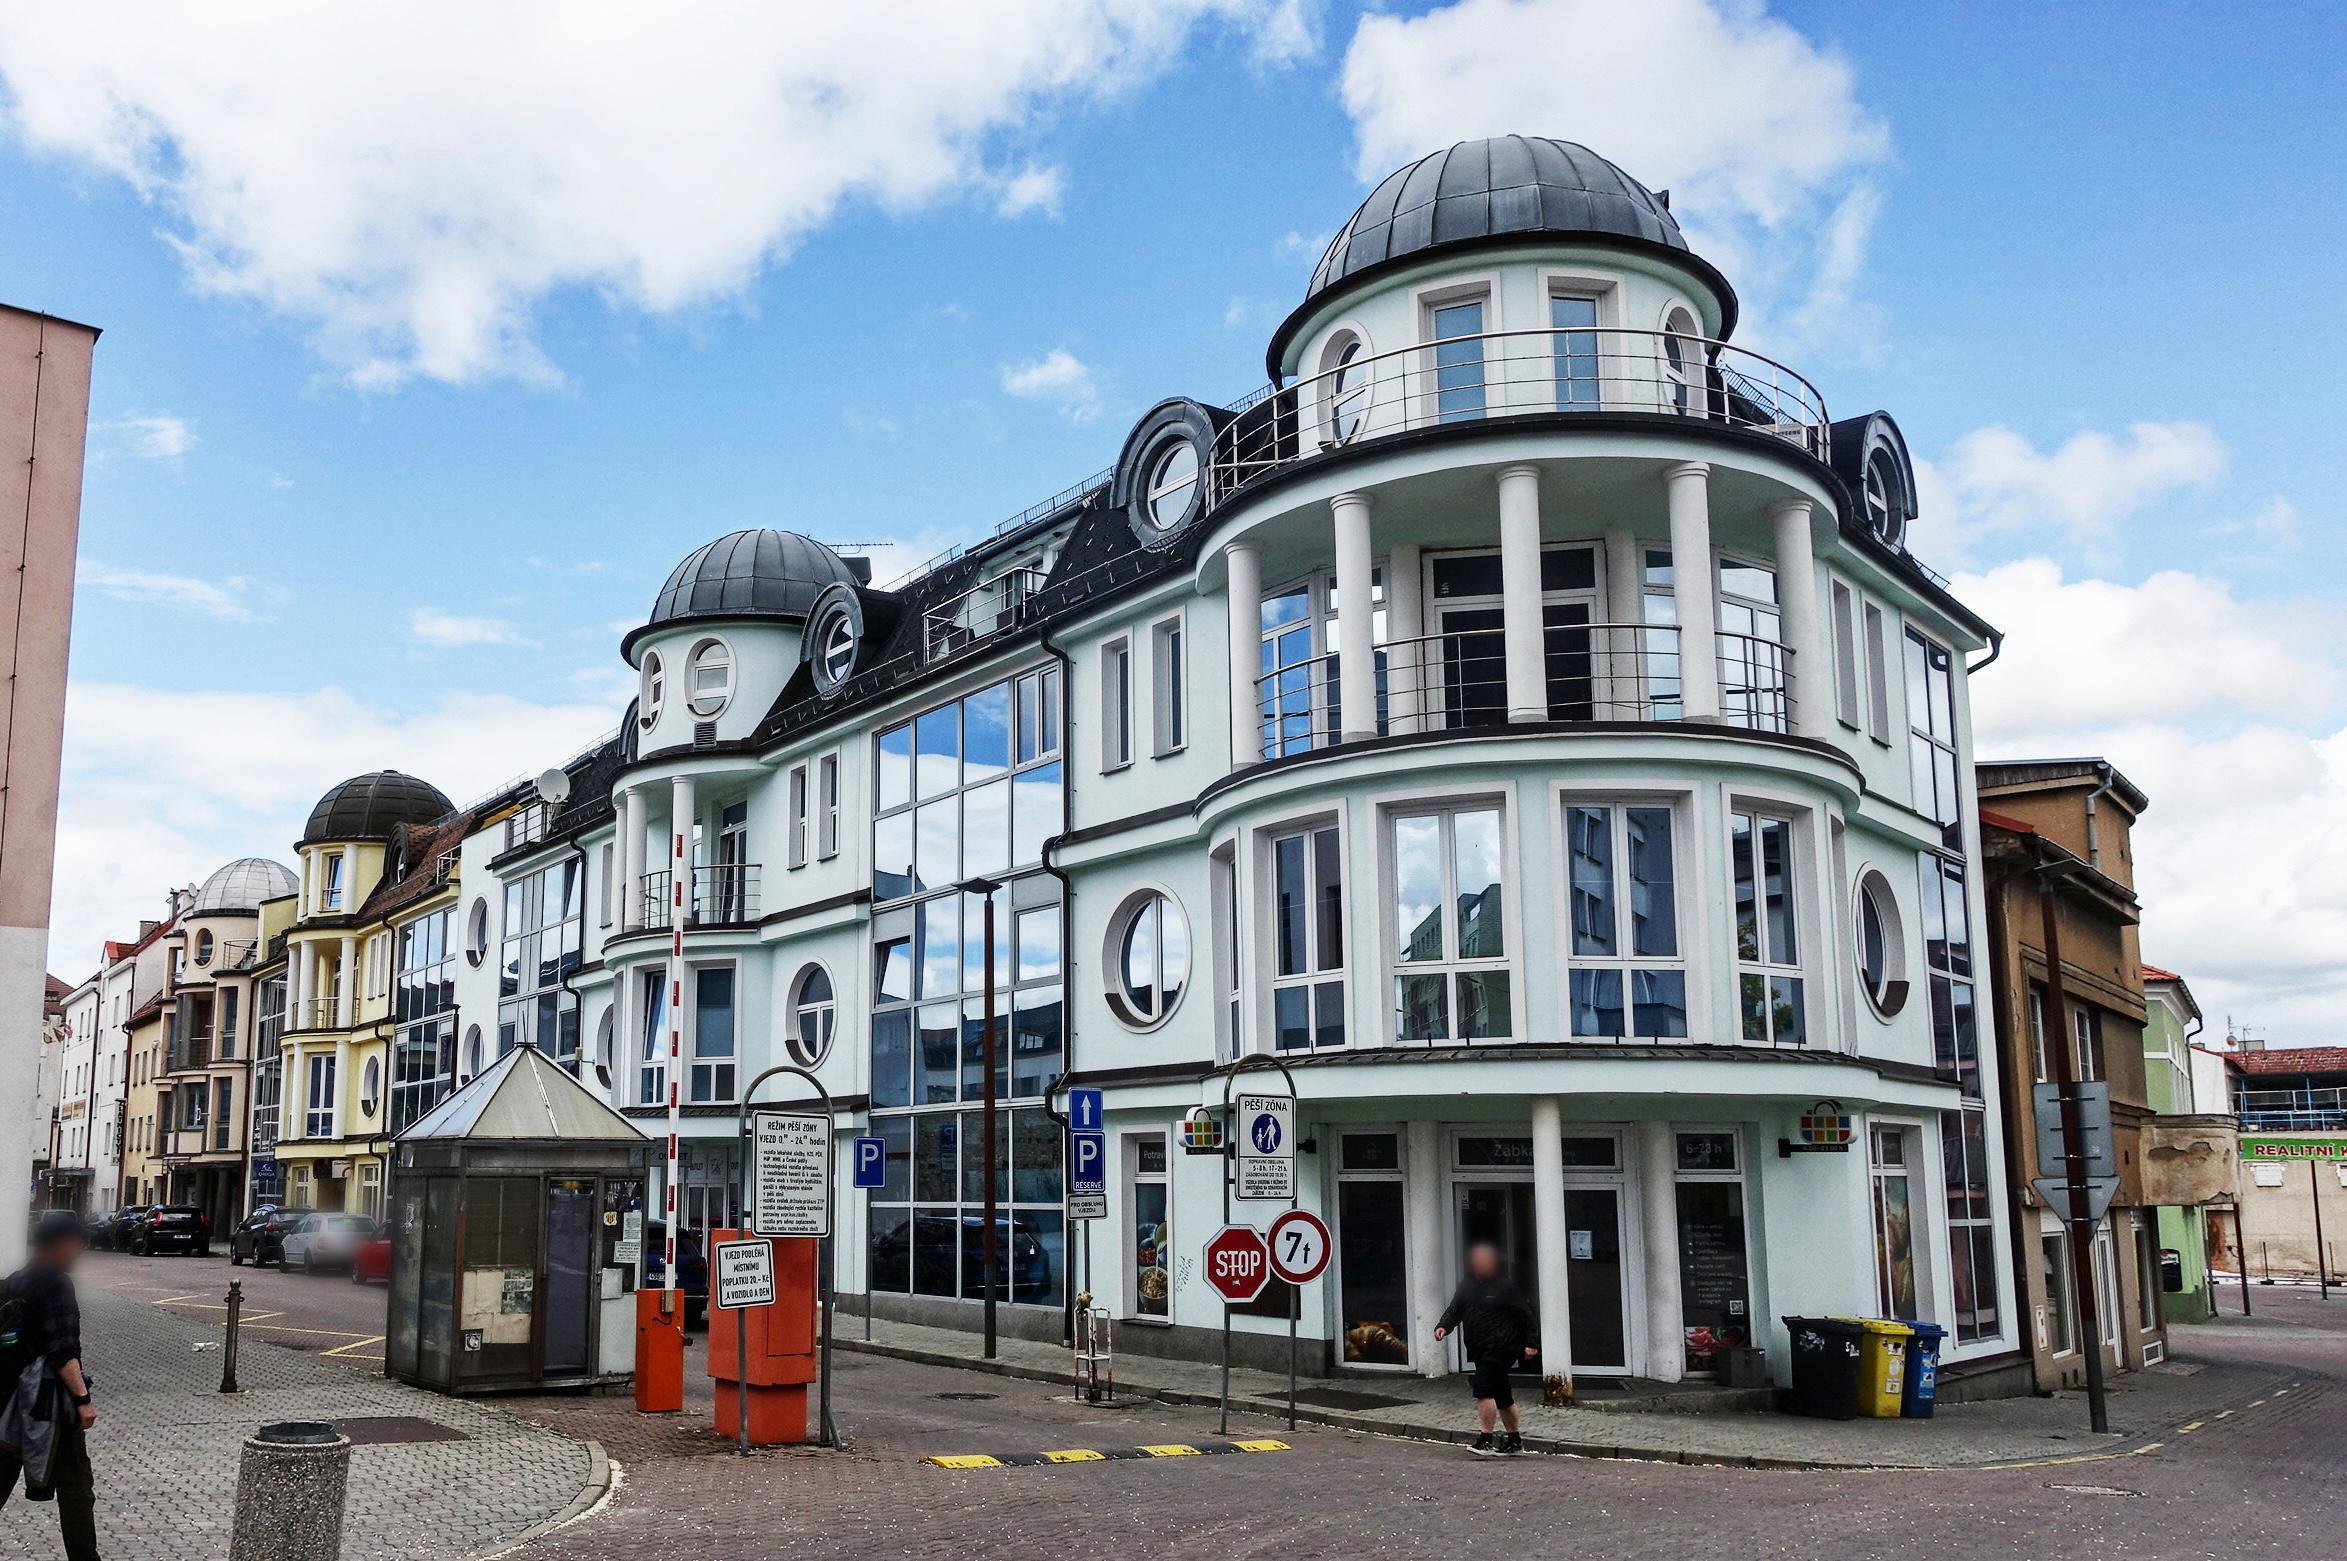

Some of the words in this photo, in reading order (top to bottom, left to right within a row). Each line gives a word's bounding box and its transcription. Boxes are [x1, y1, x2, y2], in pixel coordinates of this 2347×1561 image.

[1244, 1098, 1263, 1111] PĚŠÍ
[1265, 1099, 1288, 1112] ZÓNA
[767, 1120, 786, 1131] REŽIM
[788, 1121, 801, 1132] PĚŠÍ
[802, 1122, 818, 1132] ZÓNY
[759, 1134, 777, 1144] VJEZD
[810, 1137, 826, 1146] hodin
[658, 1152, 688, 1160] OUET
[2255, 1143, 2333, 1156] REALITNÍ
[861, 1144, 879, 1172] P
[1079, 1140, 1098, 1173] P
[725, 1250, 740, 1260] VJEZD
[741, 1246, 765, 1259] PODLÉHÁ
[733, 1261, 759, 1273] MÍSTNÍMU
[1215, 1250, 1261, 1278] STOP
[722, 1276, 749, 1287] POPLATKU
[731, 1289, 753, 1300] VOZIDLO
[754, 1289, 759, 1297] A
[759, 1287, 770, 1296] DEN
